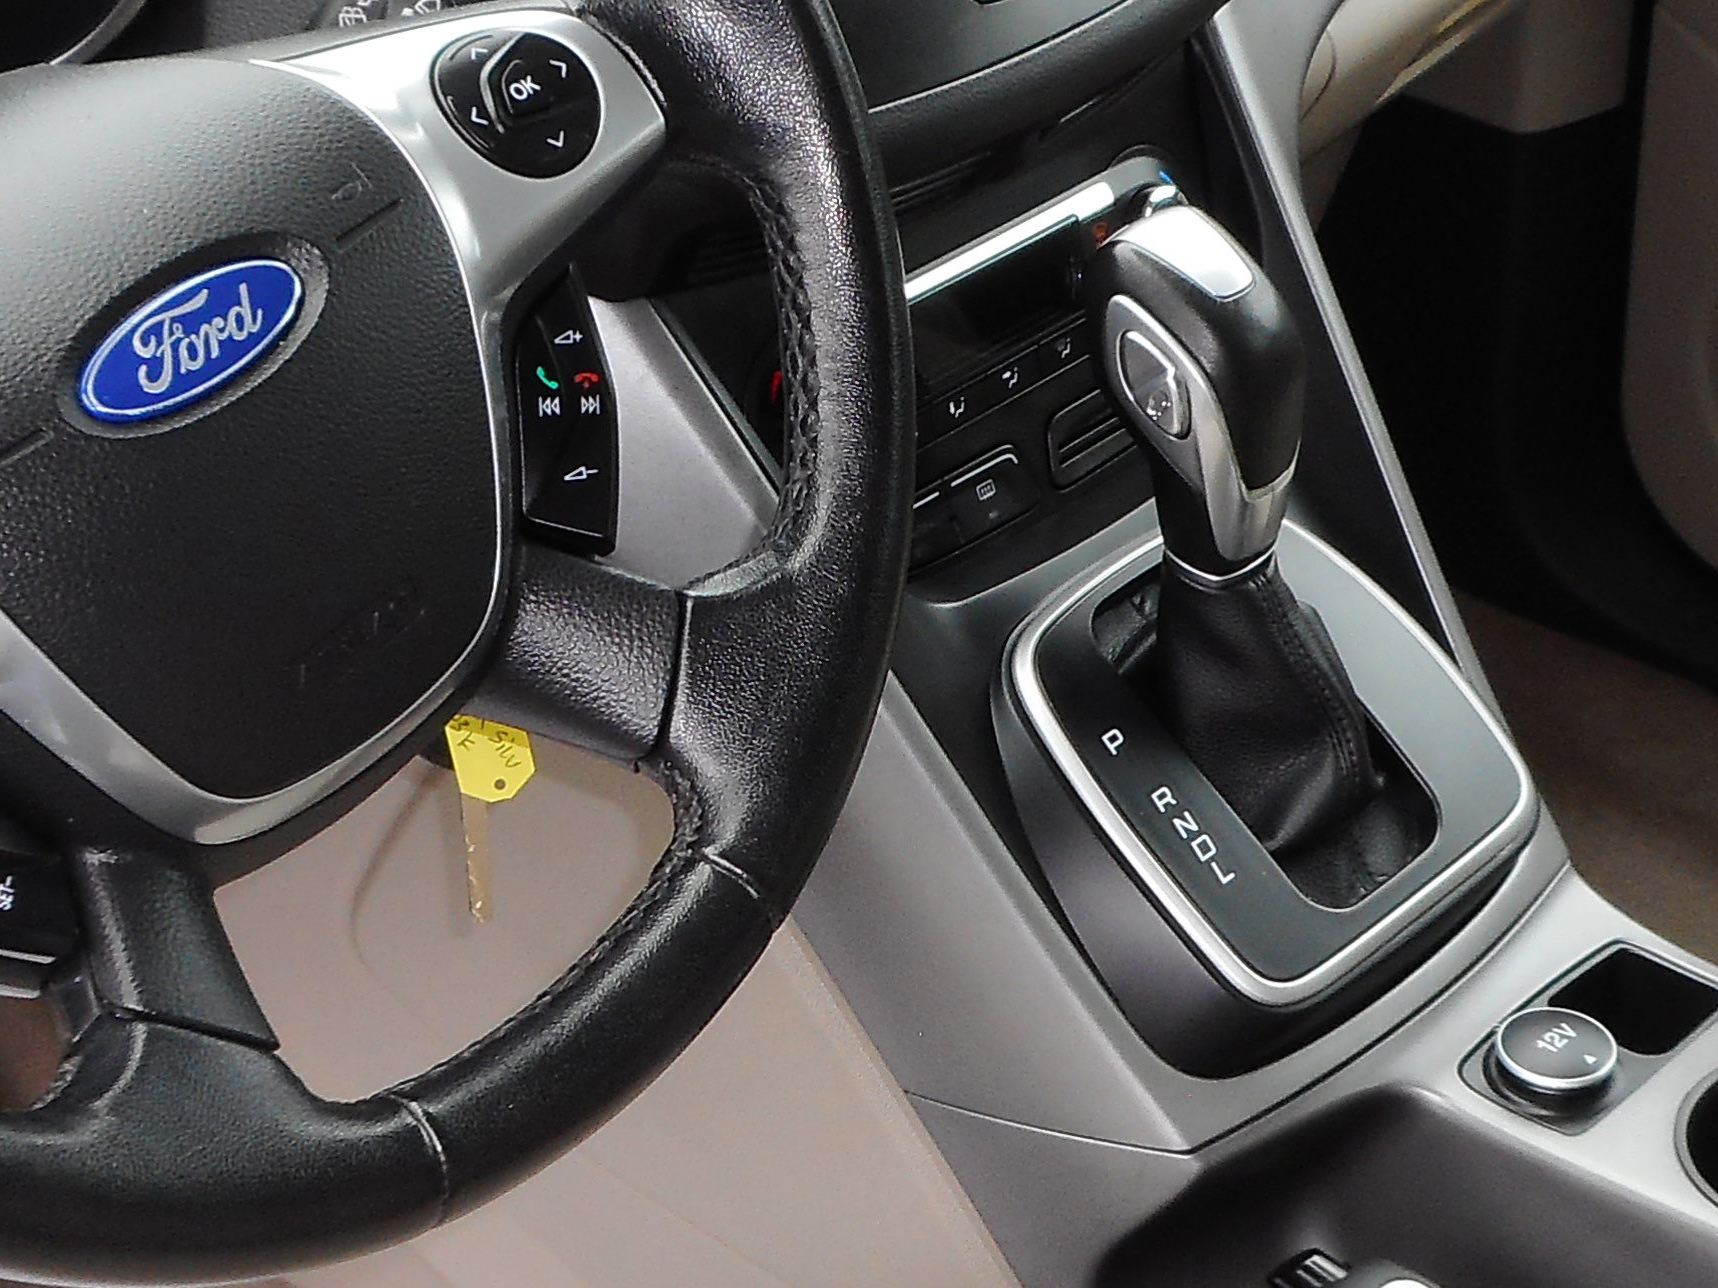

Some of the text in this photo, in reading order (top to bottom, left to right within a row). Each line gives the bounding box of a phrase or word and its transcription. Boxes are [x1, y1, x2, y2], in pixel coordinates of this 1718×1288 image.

[509, 76, 542, 101] OK
[133, 283, 262, 393] Ford
[1101, 728, 1236, 885] P R N D L
[1535, 1023, 1578, 1054] 12V
